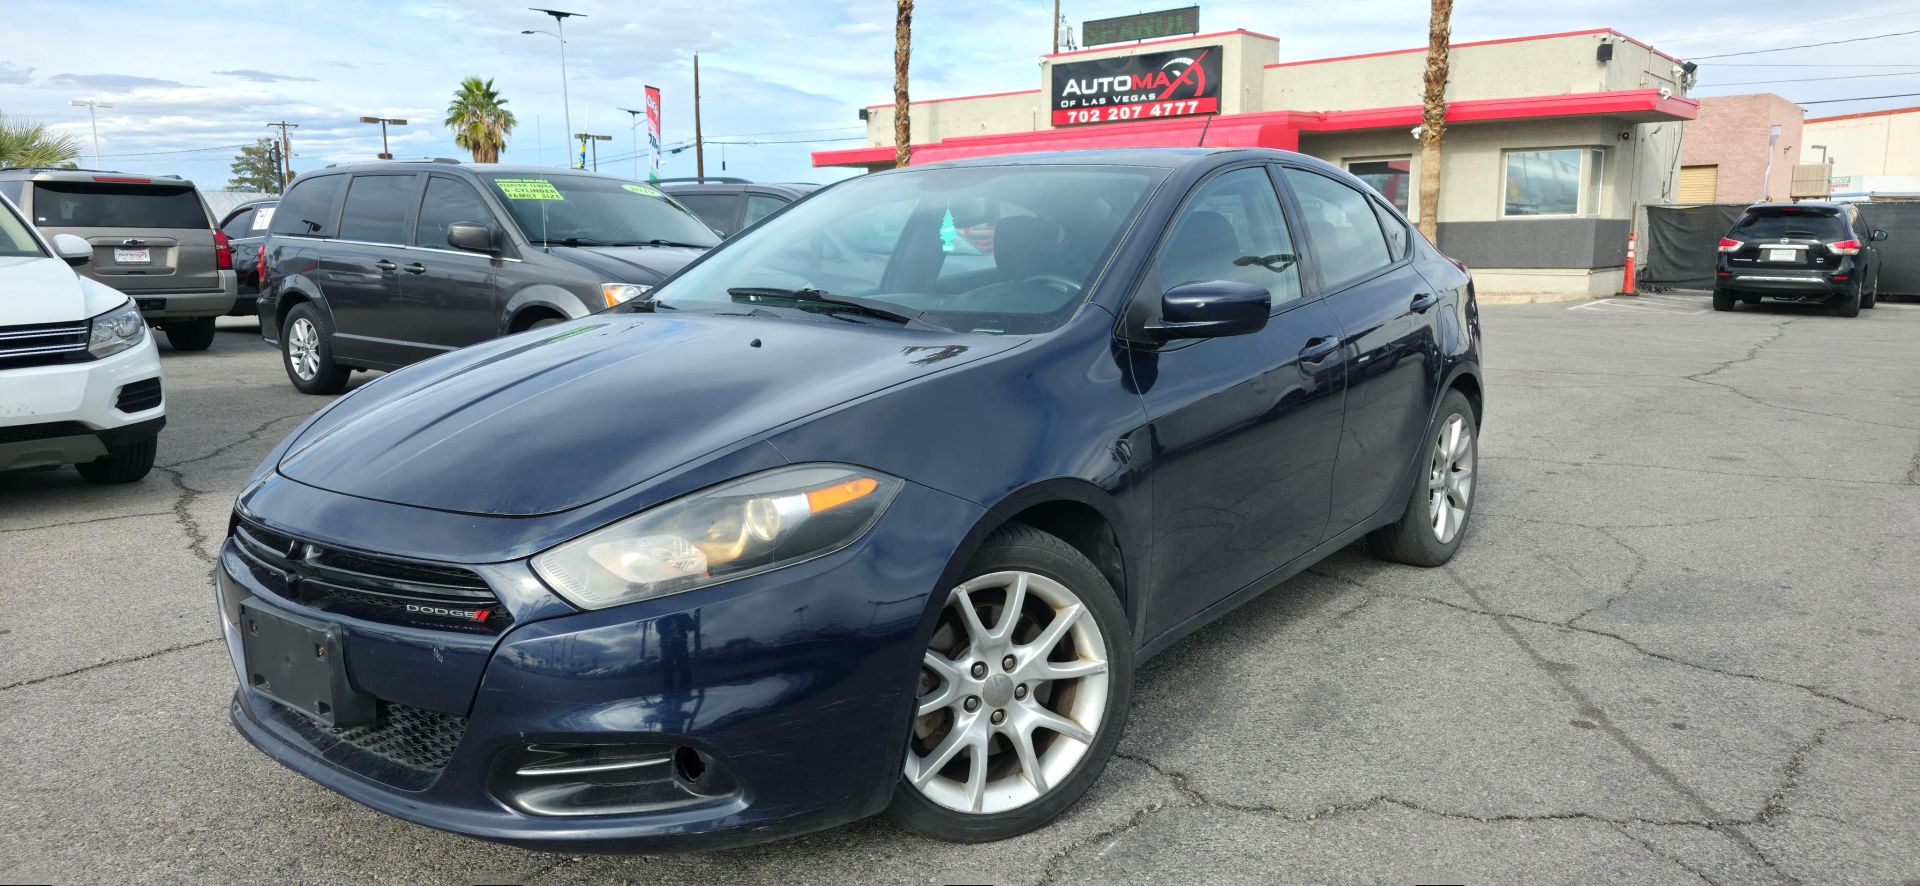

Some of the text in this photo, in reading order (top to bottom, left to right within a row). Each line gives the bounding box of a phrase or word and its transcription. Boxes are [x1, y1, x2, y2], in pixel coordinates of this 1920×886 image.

[1062, 50, 1209, 99] AUTOMAX
[1060, 93, 1156, 109] OF LAS VEGAS
[1067, 101, 1199, 124] 702 207 4777
[406, 604, 479, 619] DODGE
